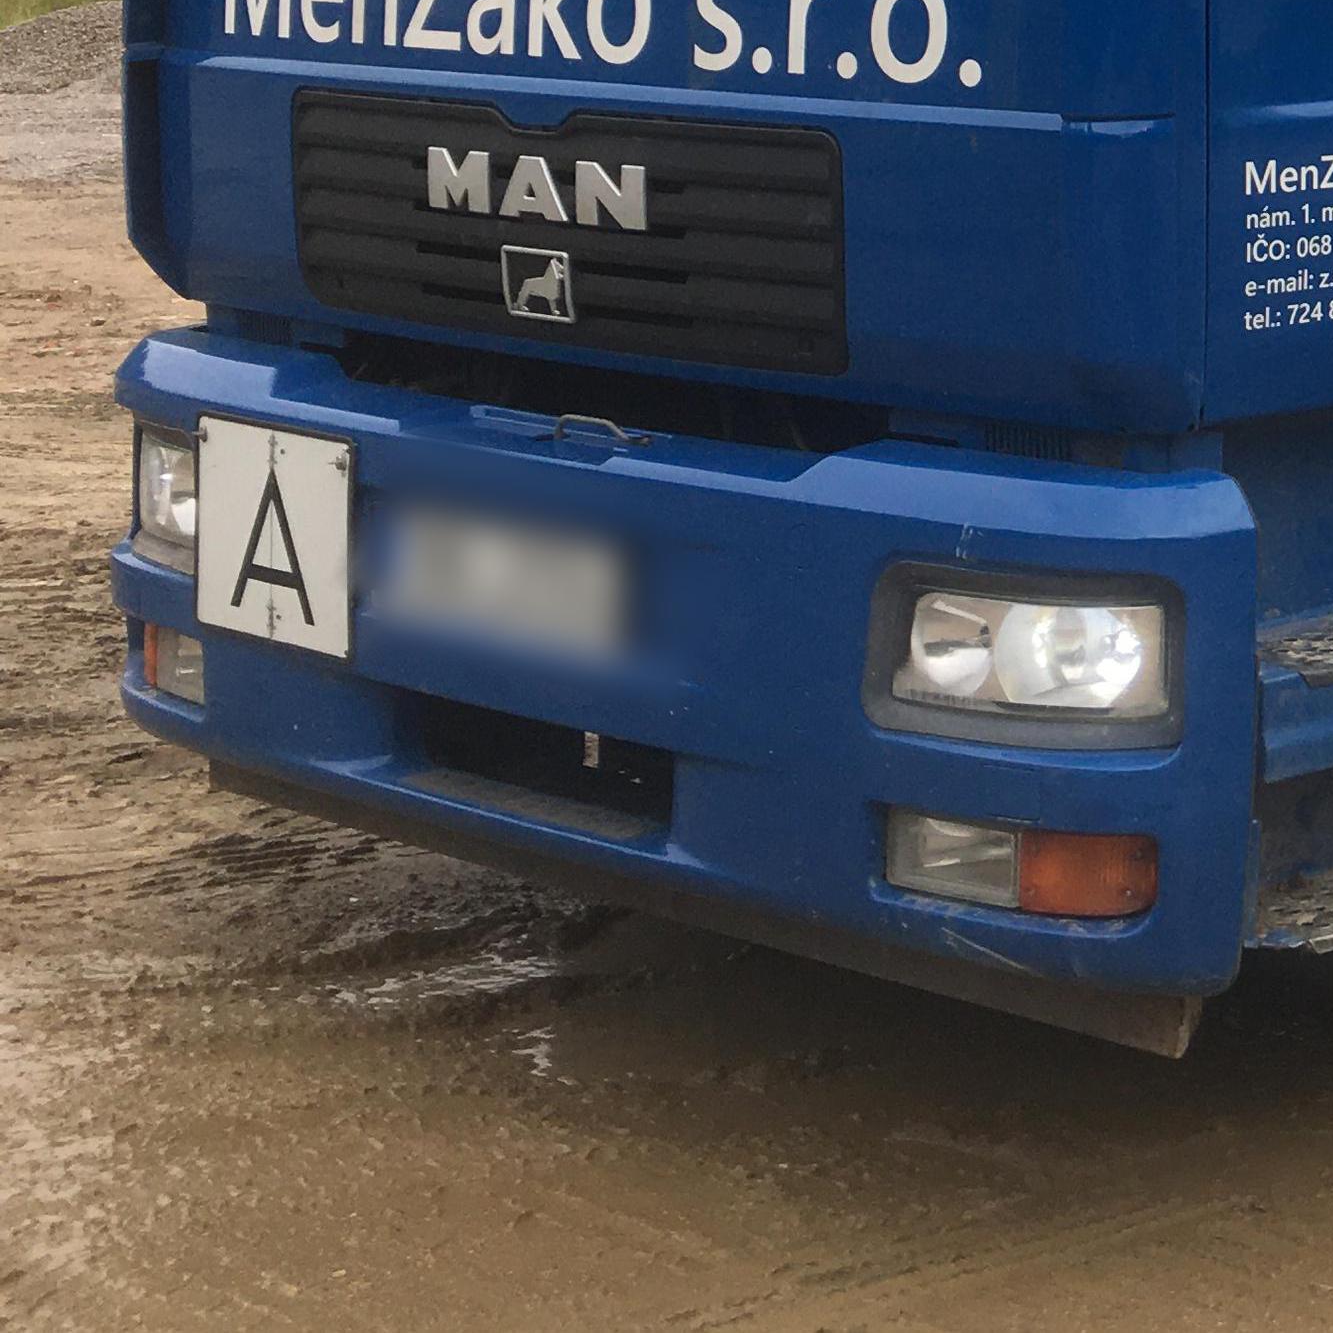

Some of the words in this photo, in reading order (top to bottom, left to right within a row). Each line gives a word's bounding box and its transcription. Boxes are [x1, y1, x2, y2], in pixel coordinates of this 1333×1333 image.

[427, 146, 646, 231] MAN
[1246, 205, 1296, 230] nám.
[1301, 203, 1316, 224] 1.
[1246, 233, 1291, 263] IČO:
[1296, 234, 1332, 258] 068
[1244, 269, 1314, 297] e-mail:
[1243, 306, 1281, 331] tel.:
[1287, 301, 1324, 325] 724
[230, 465, 315, 631] A
